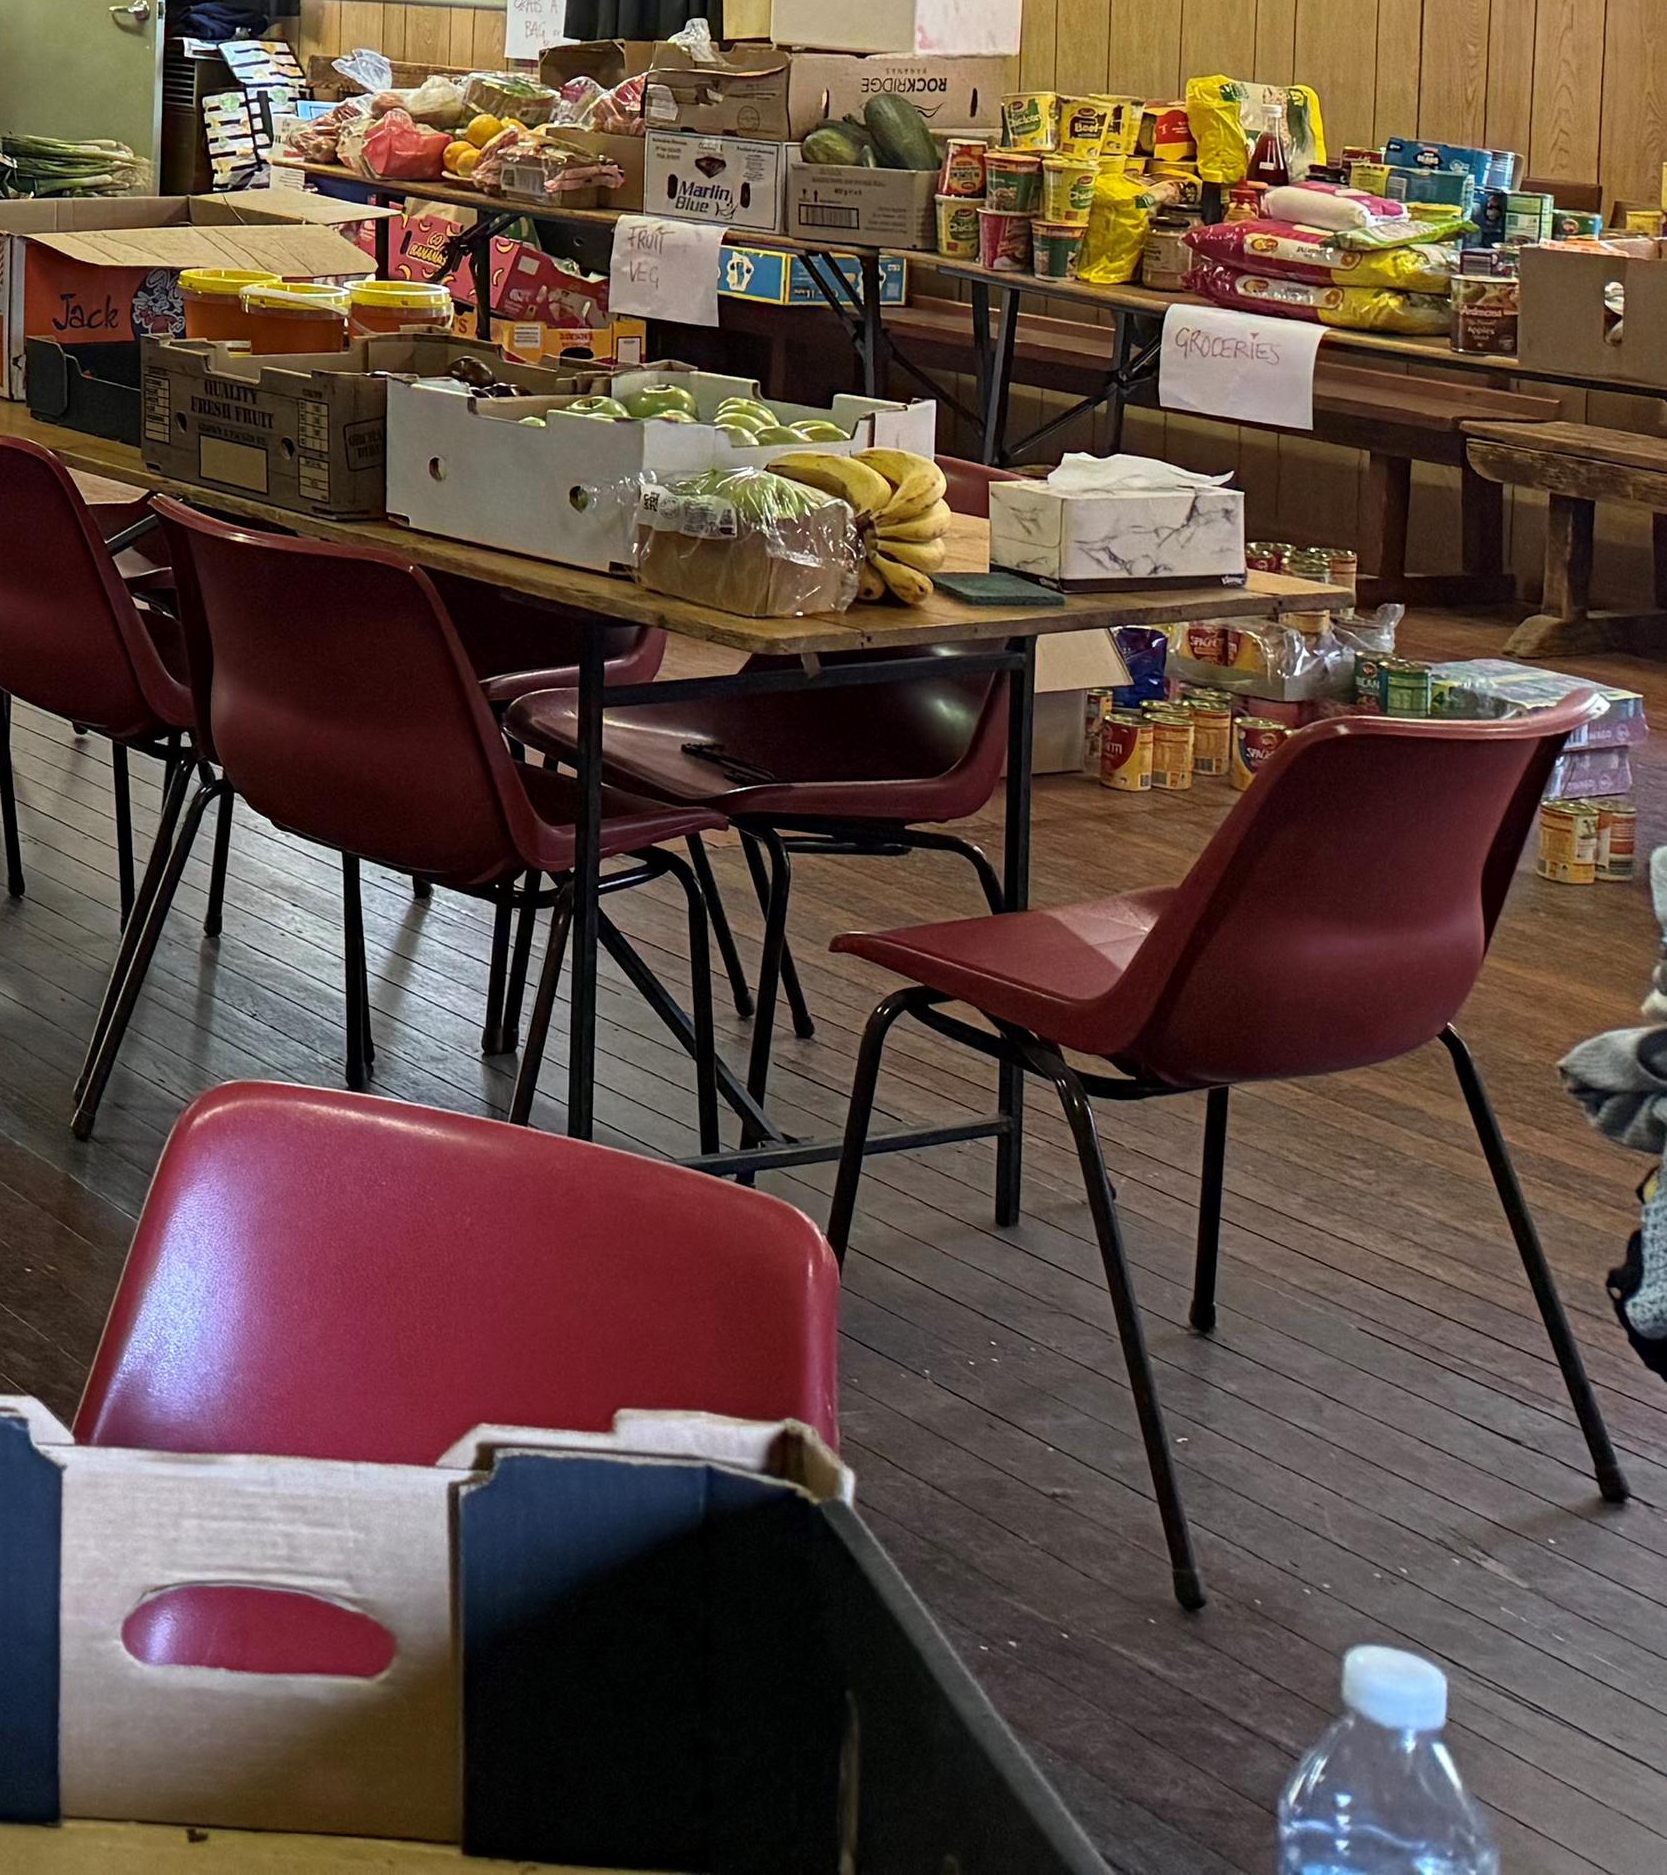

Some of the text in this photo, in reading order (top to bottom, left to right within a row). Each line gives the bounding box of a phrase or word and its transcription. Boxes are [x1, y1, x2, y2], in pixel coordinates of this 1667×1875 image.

[525, 21, 546, 39] BAG
[861, 77, 948, 93] ROCKRIDGE
[1074, 123, 1099, 133] Beef
[675, 195, 709, 213] Blue
[678, 179, 731, 204] Marlin
[627, 225, 676, 255] FRUIT
[628, 260, 660, 288] VEG
[52, 292, 119, 332] Jack
[1175, 326, 1281, 365] GROCERIES
[204, 379, 259, 405] QUALITY
[191, 396, 275, 429] FRESH FRUIT
